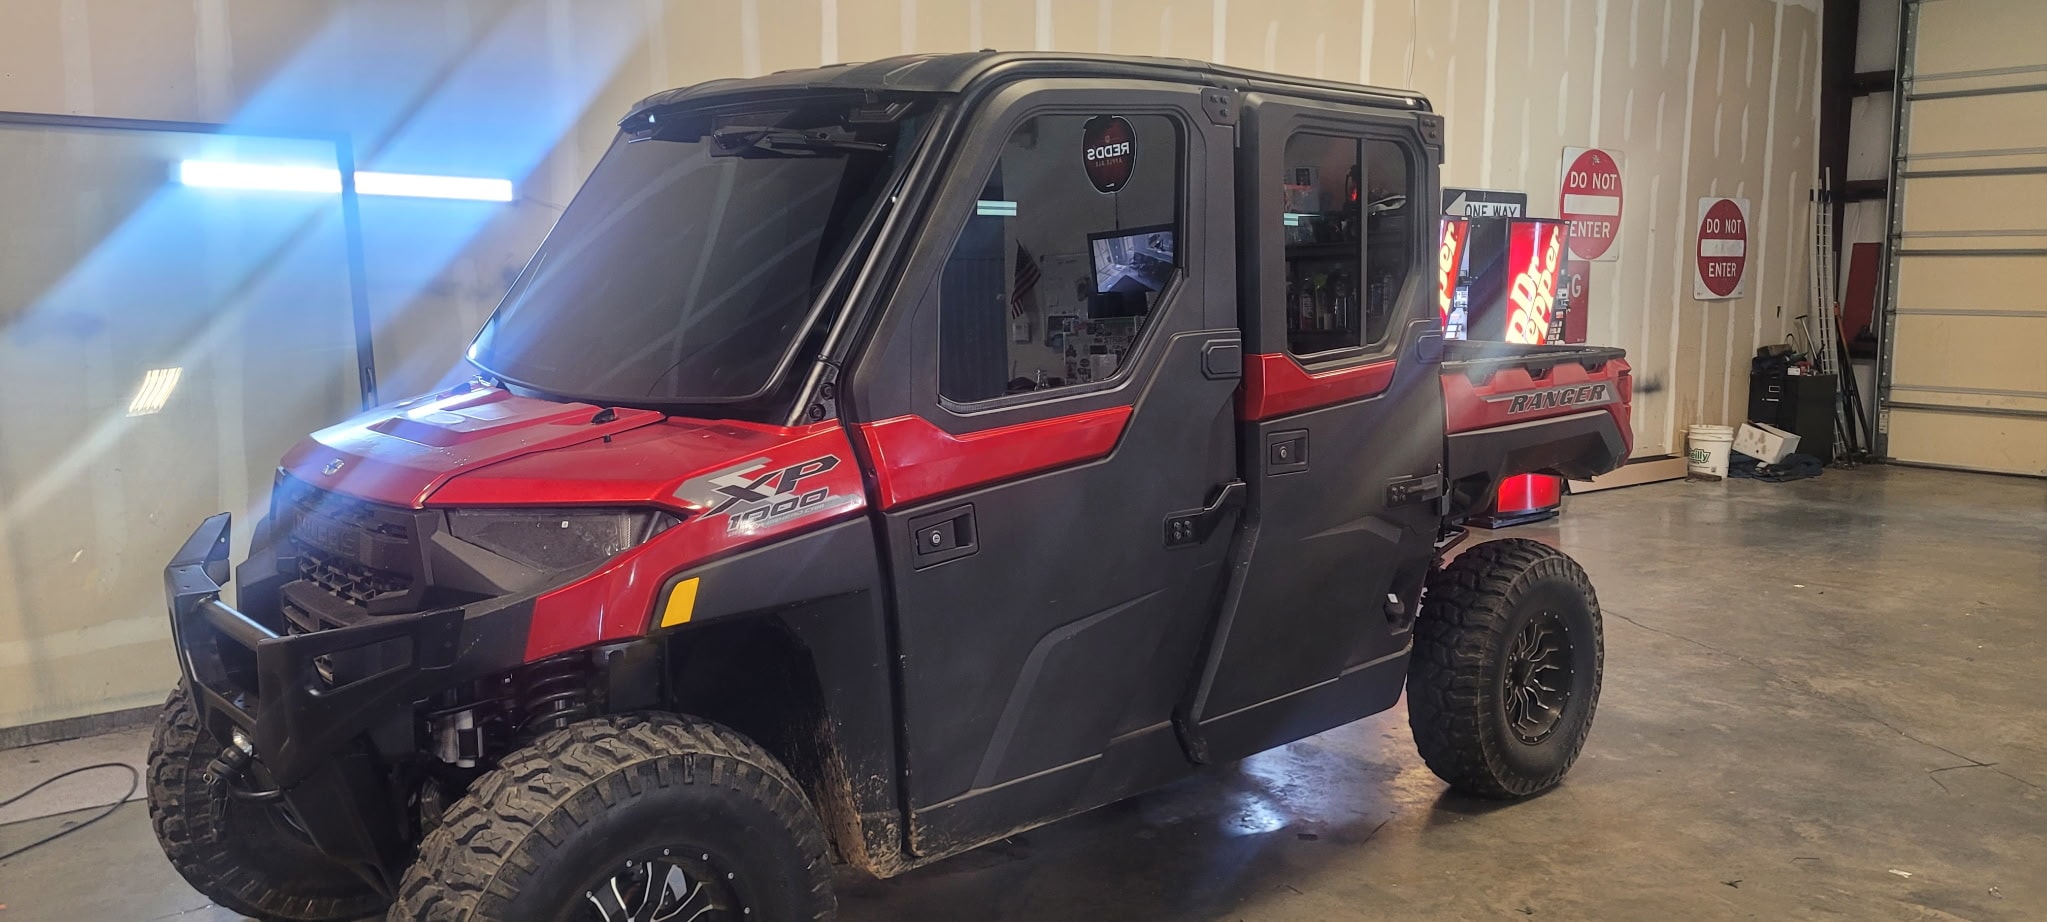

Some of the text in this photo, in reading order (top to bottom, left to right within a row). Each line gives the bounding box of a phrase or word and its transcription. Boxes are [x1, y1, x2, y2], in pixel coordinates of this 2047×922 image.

[1570, 171, 1617, 190] DO NOT
[1465, 203, 1518, 217] ONE WAY
[1569, 220, 1611, 239] ENTER
[1706, 218, 1742, 233] DO NOT
[1708, 262, 1737, 278] ENTER
[1508, 384, 1606, 414] RANGER
[694, 454, 841, 522] XP
[727, 486, 830, 532] 1000
